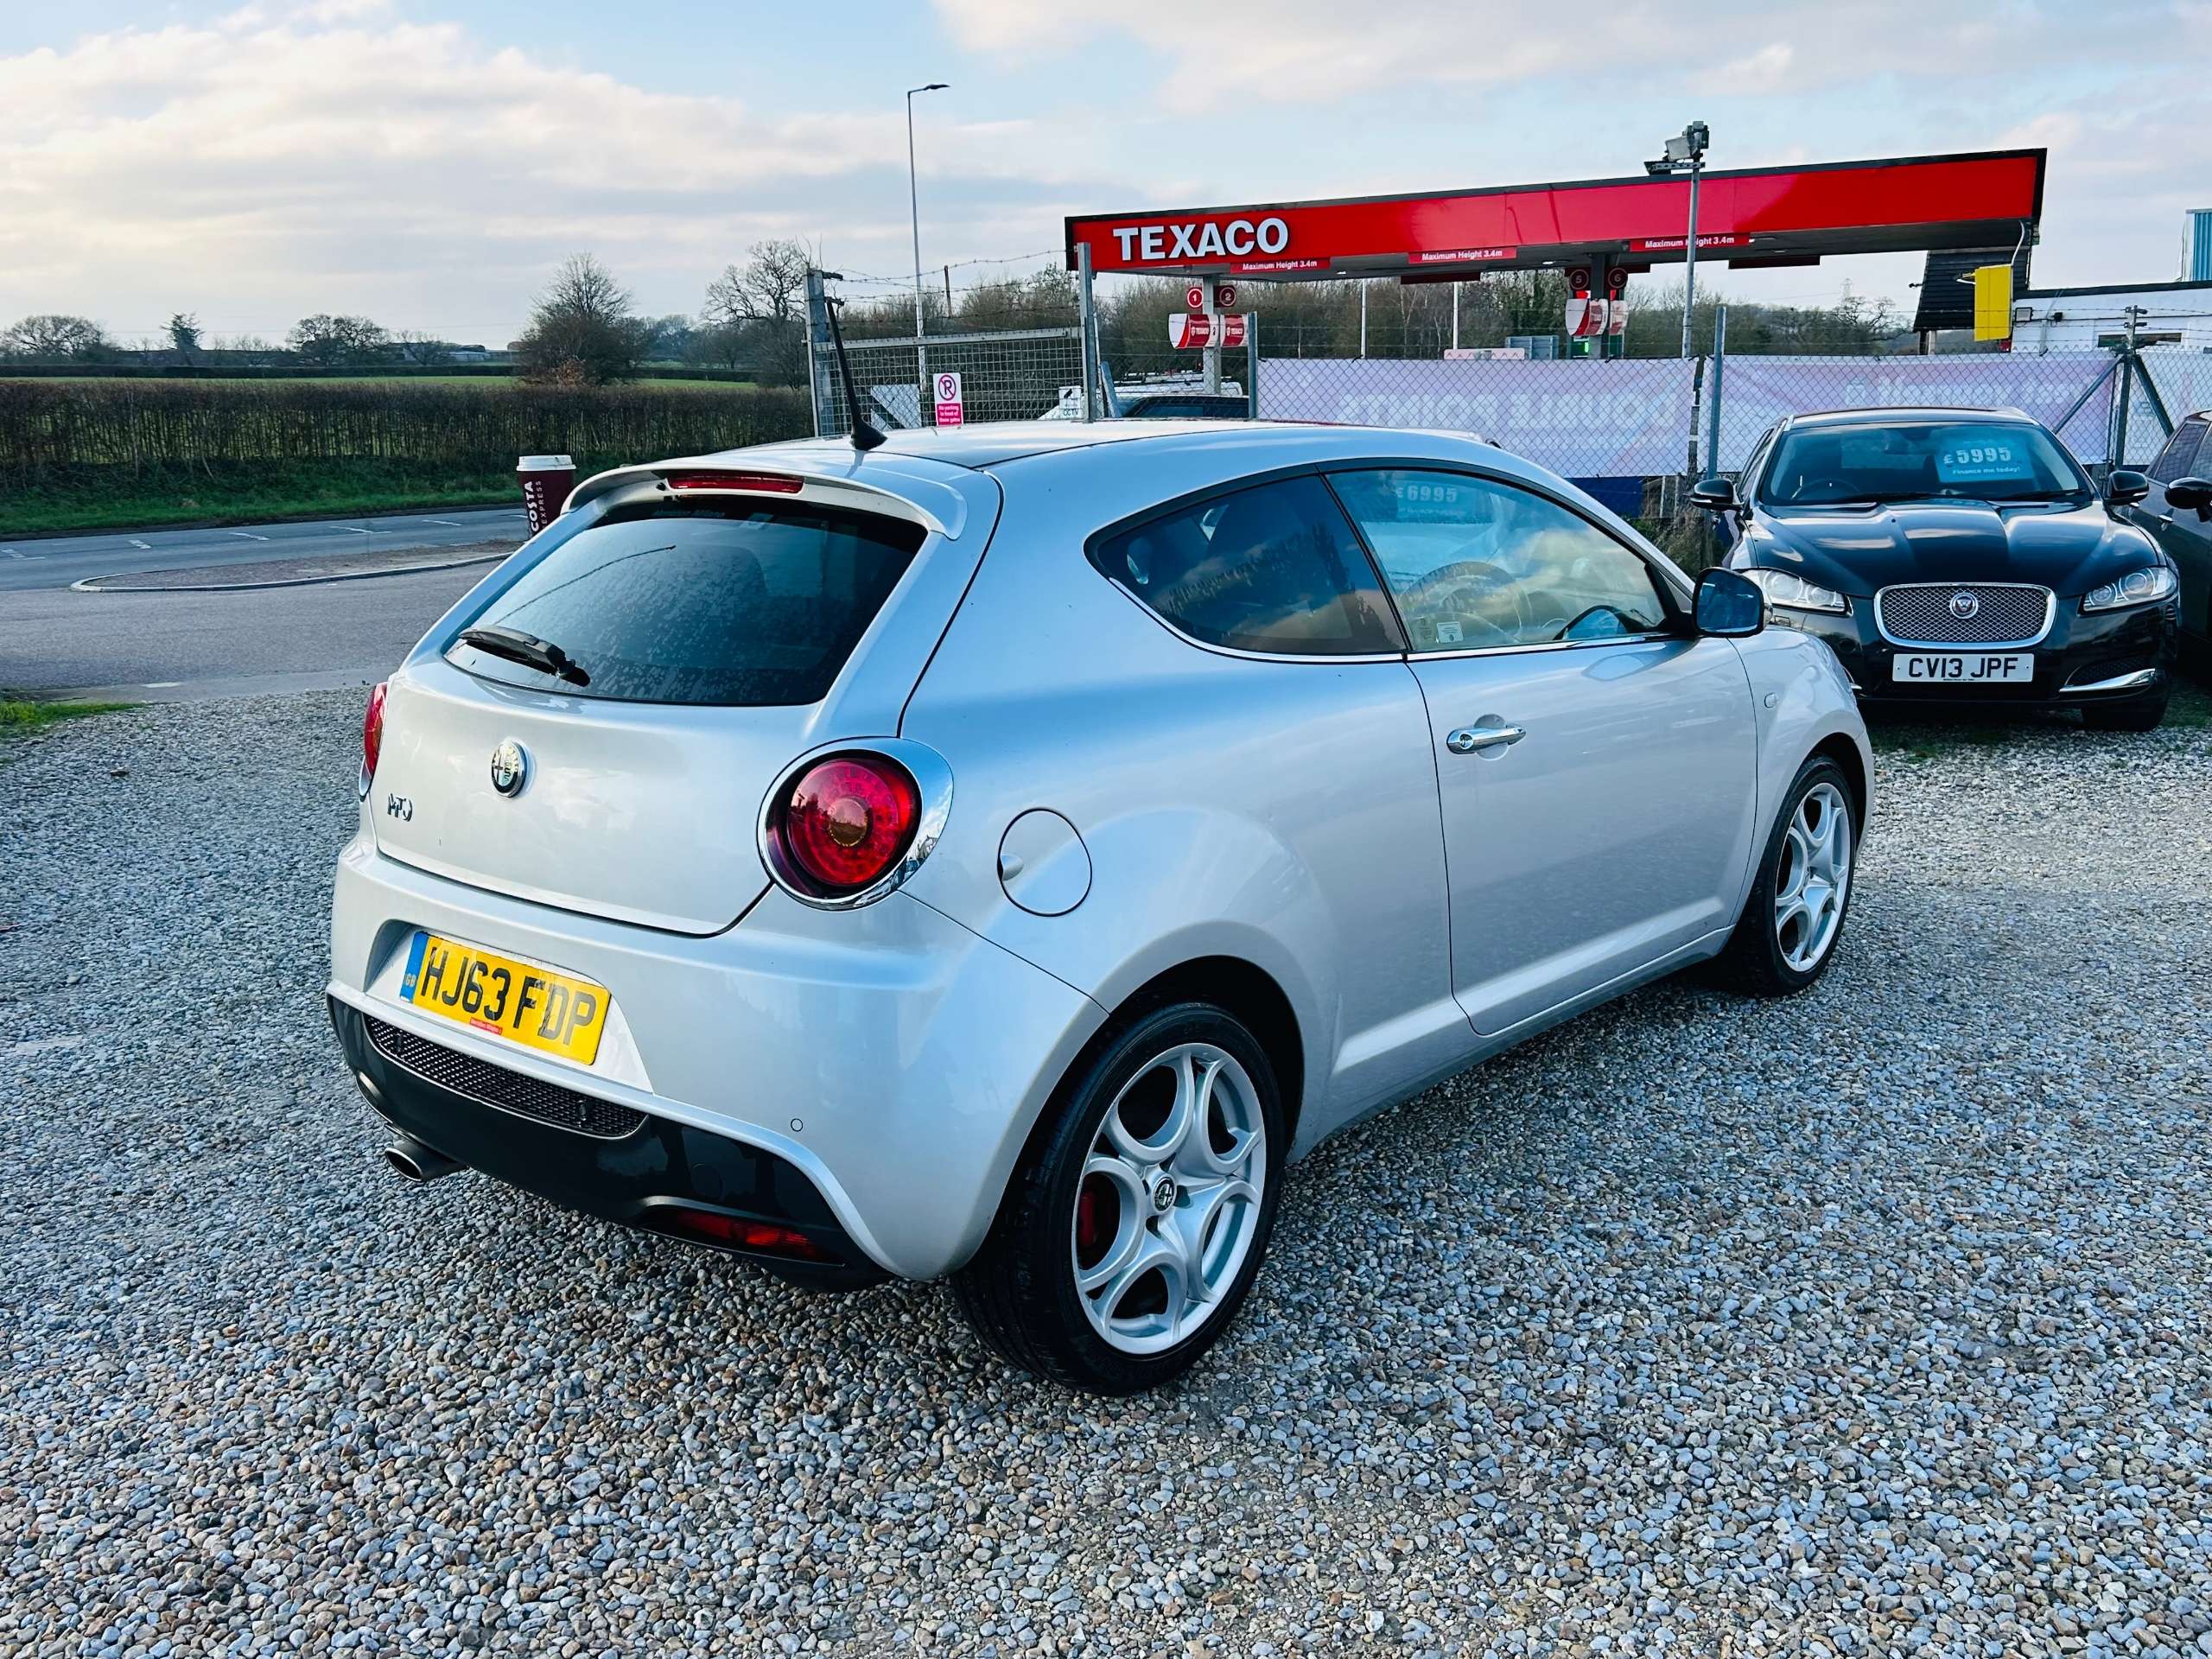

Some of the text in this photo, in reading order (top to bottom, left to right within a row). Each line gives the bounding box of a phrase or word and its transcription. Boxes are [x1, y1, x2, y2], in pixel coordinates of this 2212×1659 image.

[1112, 217, 1289, 262] TEXACO
[1644, 236, 1735, 249] Maximum ight 3.4m
[1242, 263, 1274, 271] Maximum
[1275, 261, 1298, 270] Height
[1421, 252, 1457, 261] Maximum
[1458, 251, 1483, 260] Height
[524, 480, 539, 532] COSTA
[535, 480, 548, 524] EXPRESS
[1908, 657, 2018, 678] CV13 JPF
[404, 973, 416, 987] GB
[420, 946, 597, 1046] HJ63 FDP
